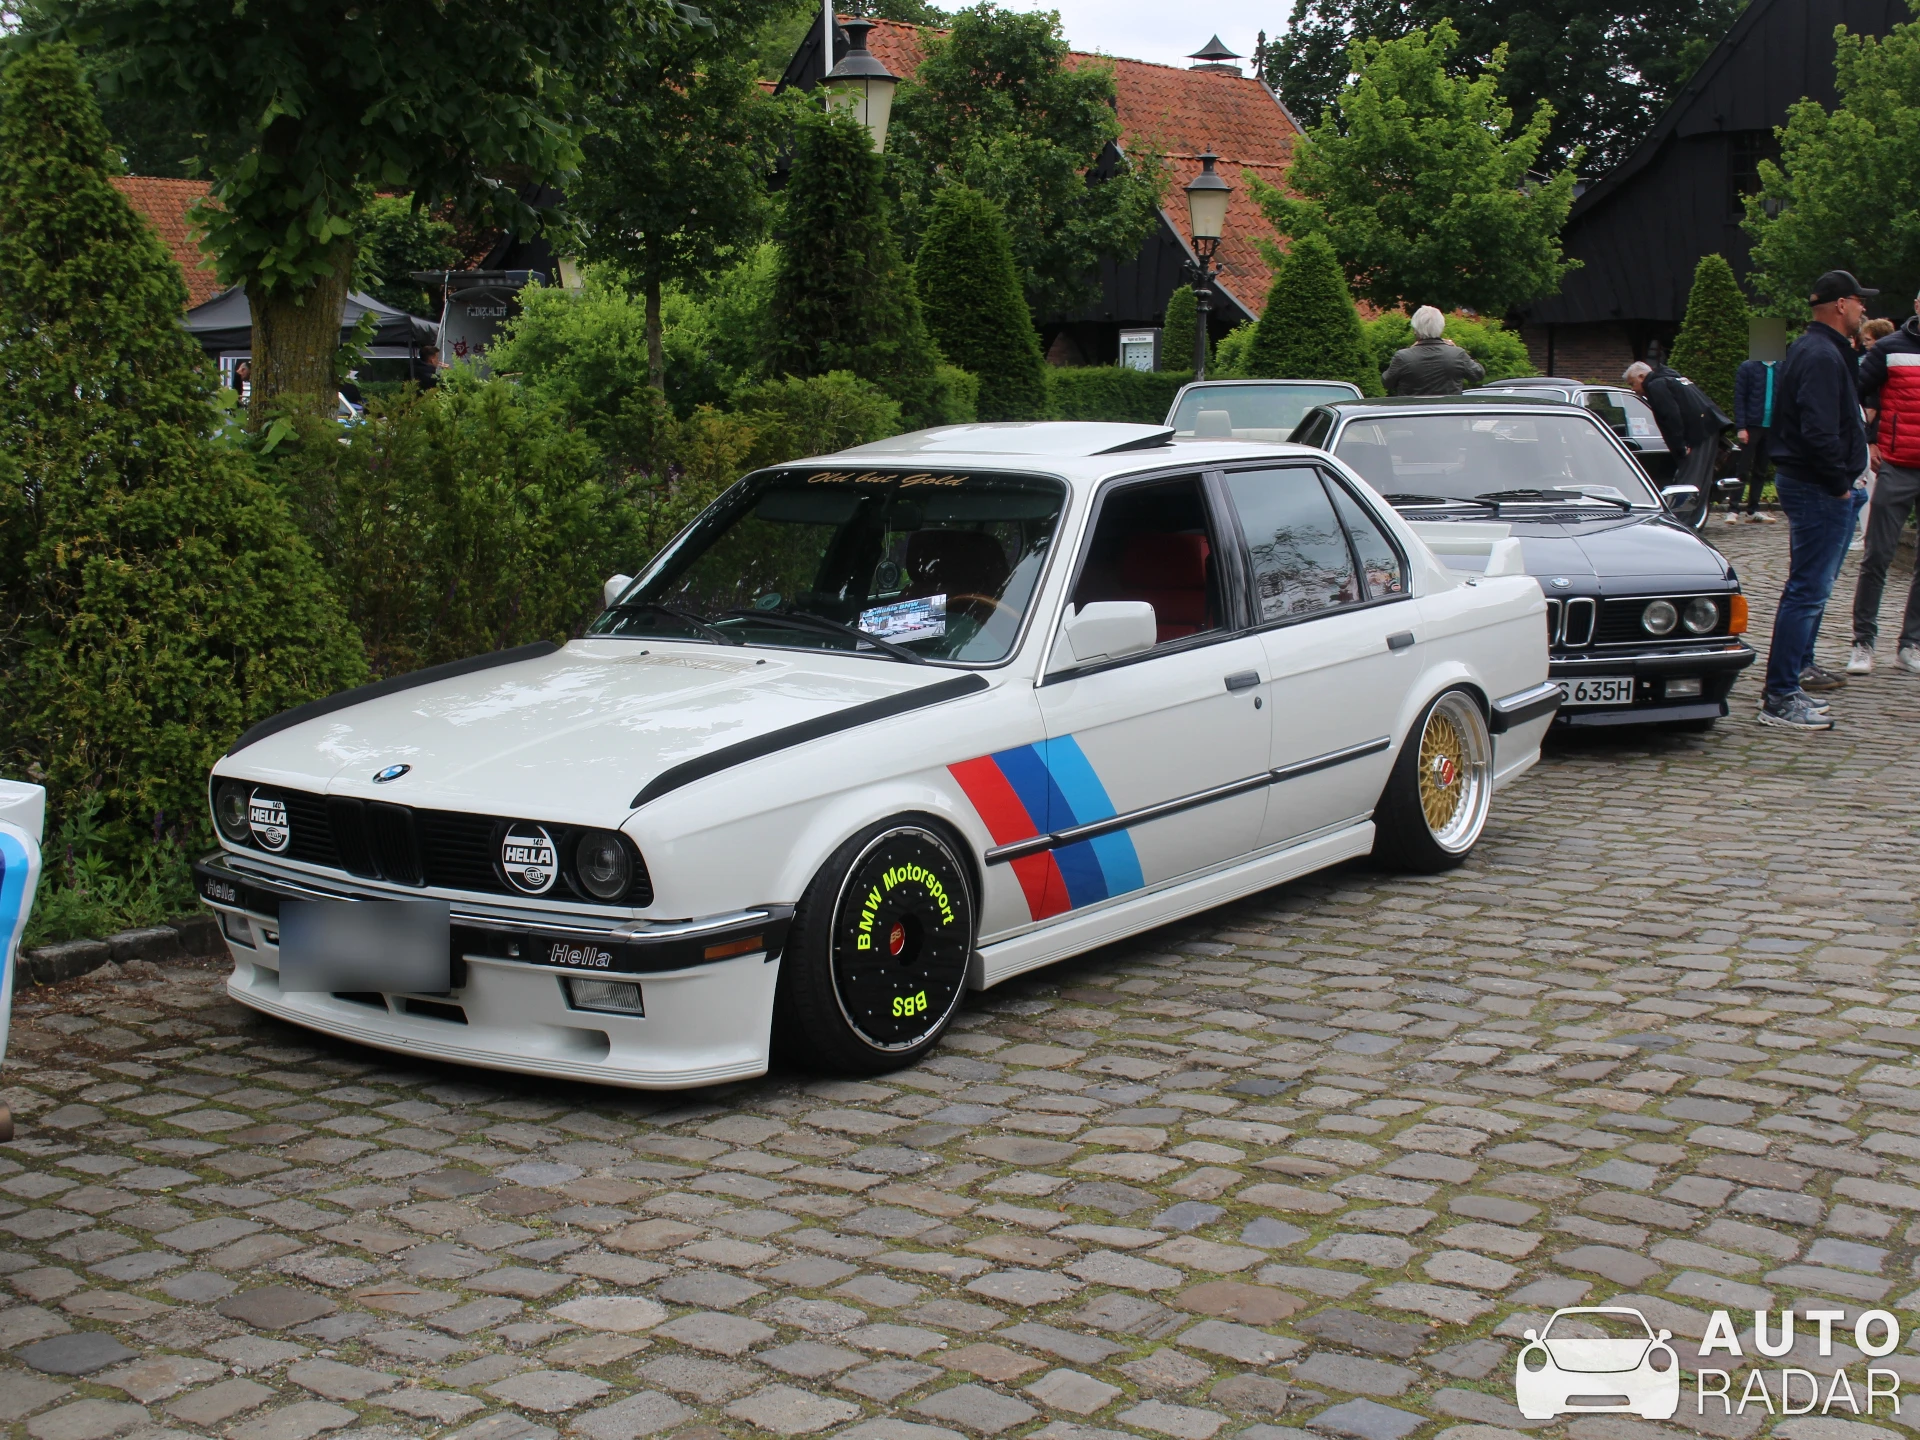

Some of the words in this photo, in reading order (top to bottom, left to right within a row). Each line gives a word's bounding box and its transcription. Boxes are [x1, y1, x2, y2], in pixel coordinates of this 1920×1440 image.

[807, 472, 855, 484] Old
[855, 471, 898, 483] but
[899, 473, 969, 488] Gold
[1575, 681, 1631, 702] 635H
[250, 808, 287, 825] HELLA
[505, 846, 551, 864] HELLA
[207, 879, 236, 902] Hella
[857, 885, 884, 951] BMW
[882, 863, 955, 926] Motorsport
[550, 943, 611, 968] Hella
[892, 990, 928, 1017] BBS
